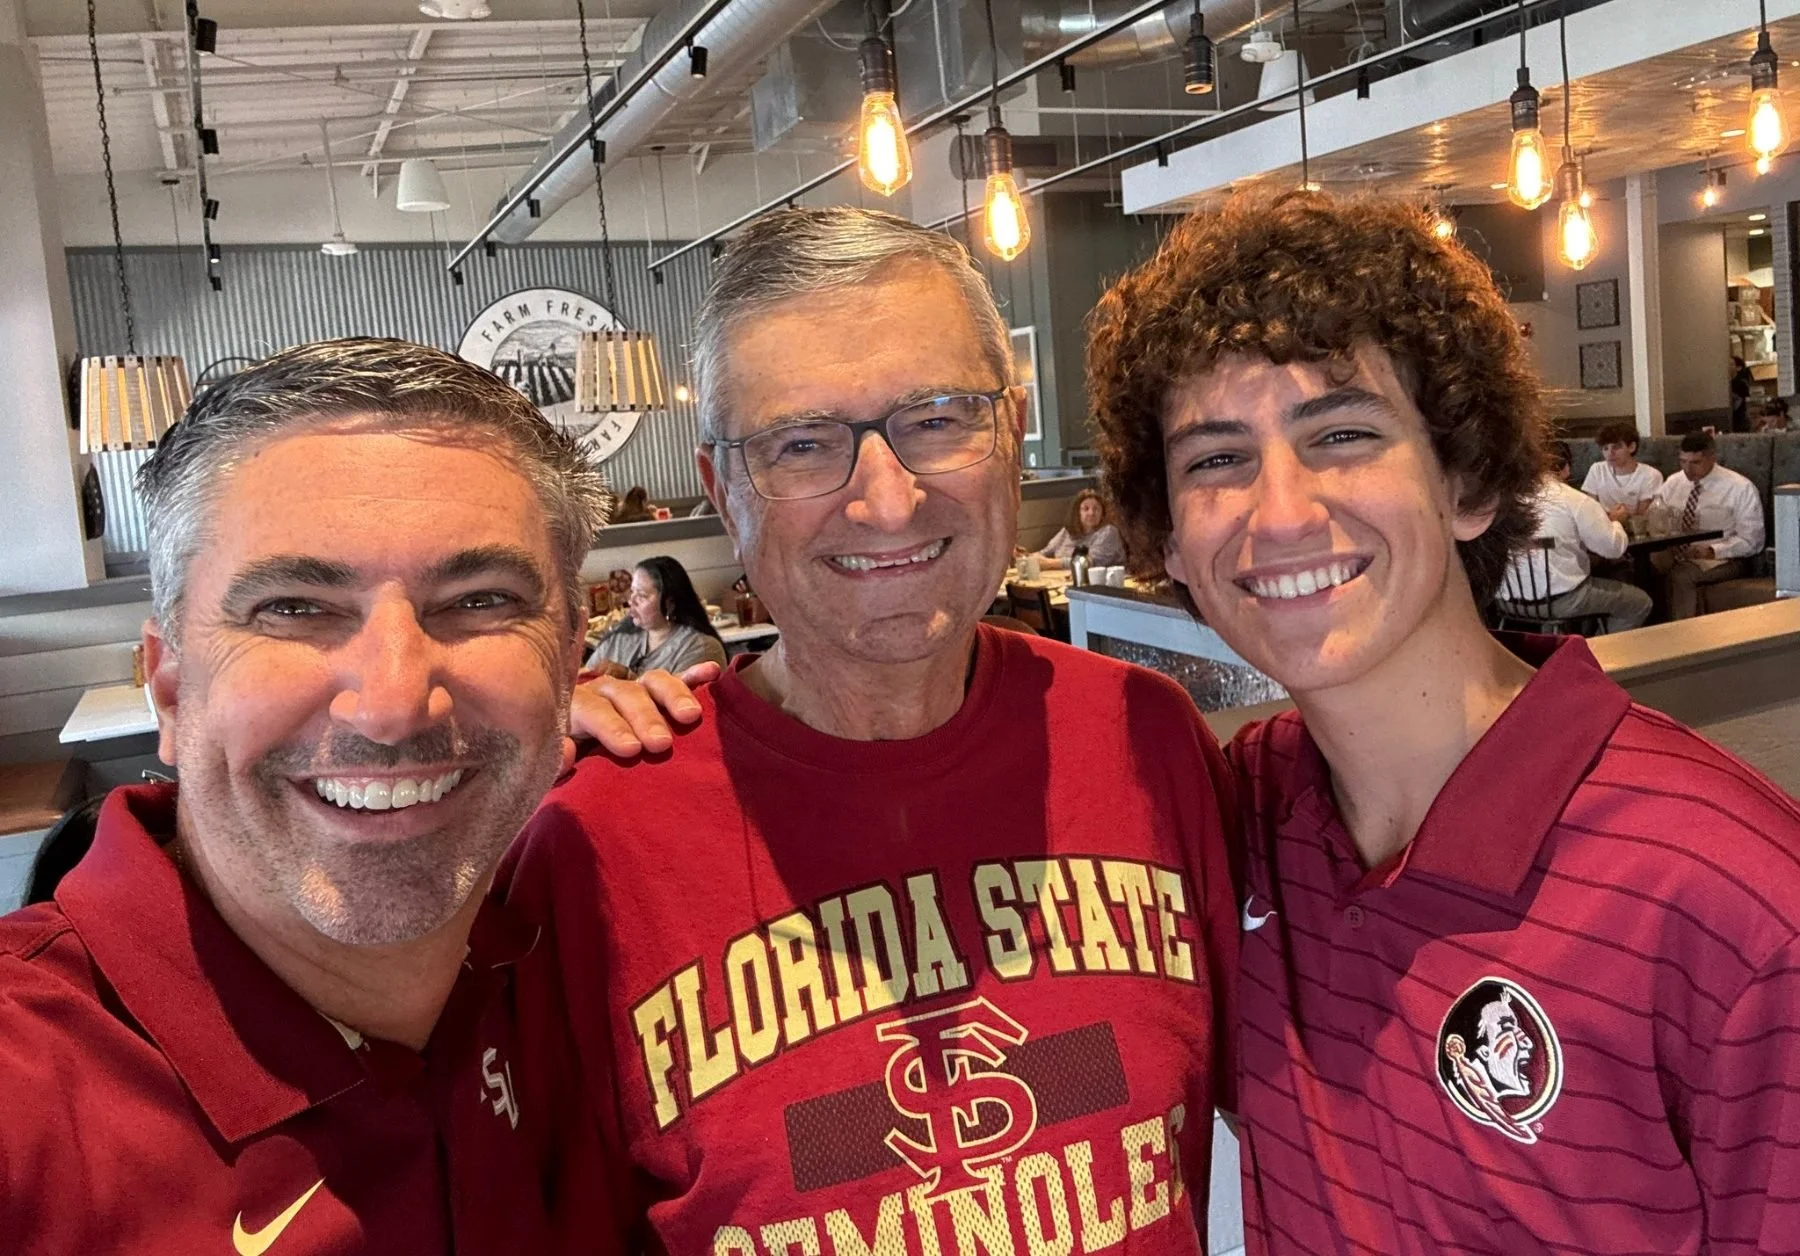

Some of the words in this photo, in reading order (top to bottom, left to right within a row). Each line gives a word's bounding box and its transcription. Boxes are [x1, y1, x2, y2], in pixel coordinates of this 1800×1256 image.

[481, 302, 532, 343] FARM
[587, 419, 623, 453] FAR
[629, 870, 974, 1133] FLORIDA
[968, 855, 1198, 983] STATE
